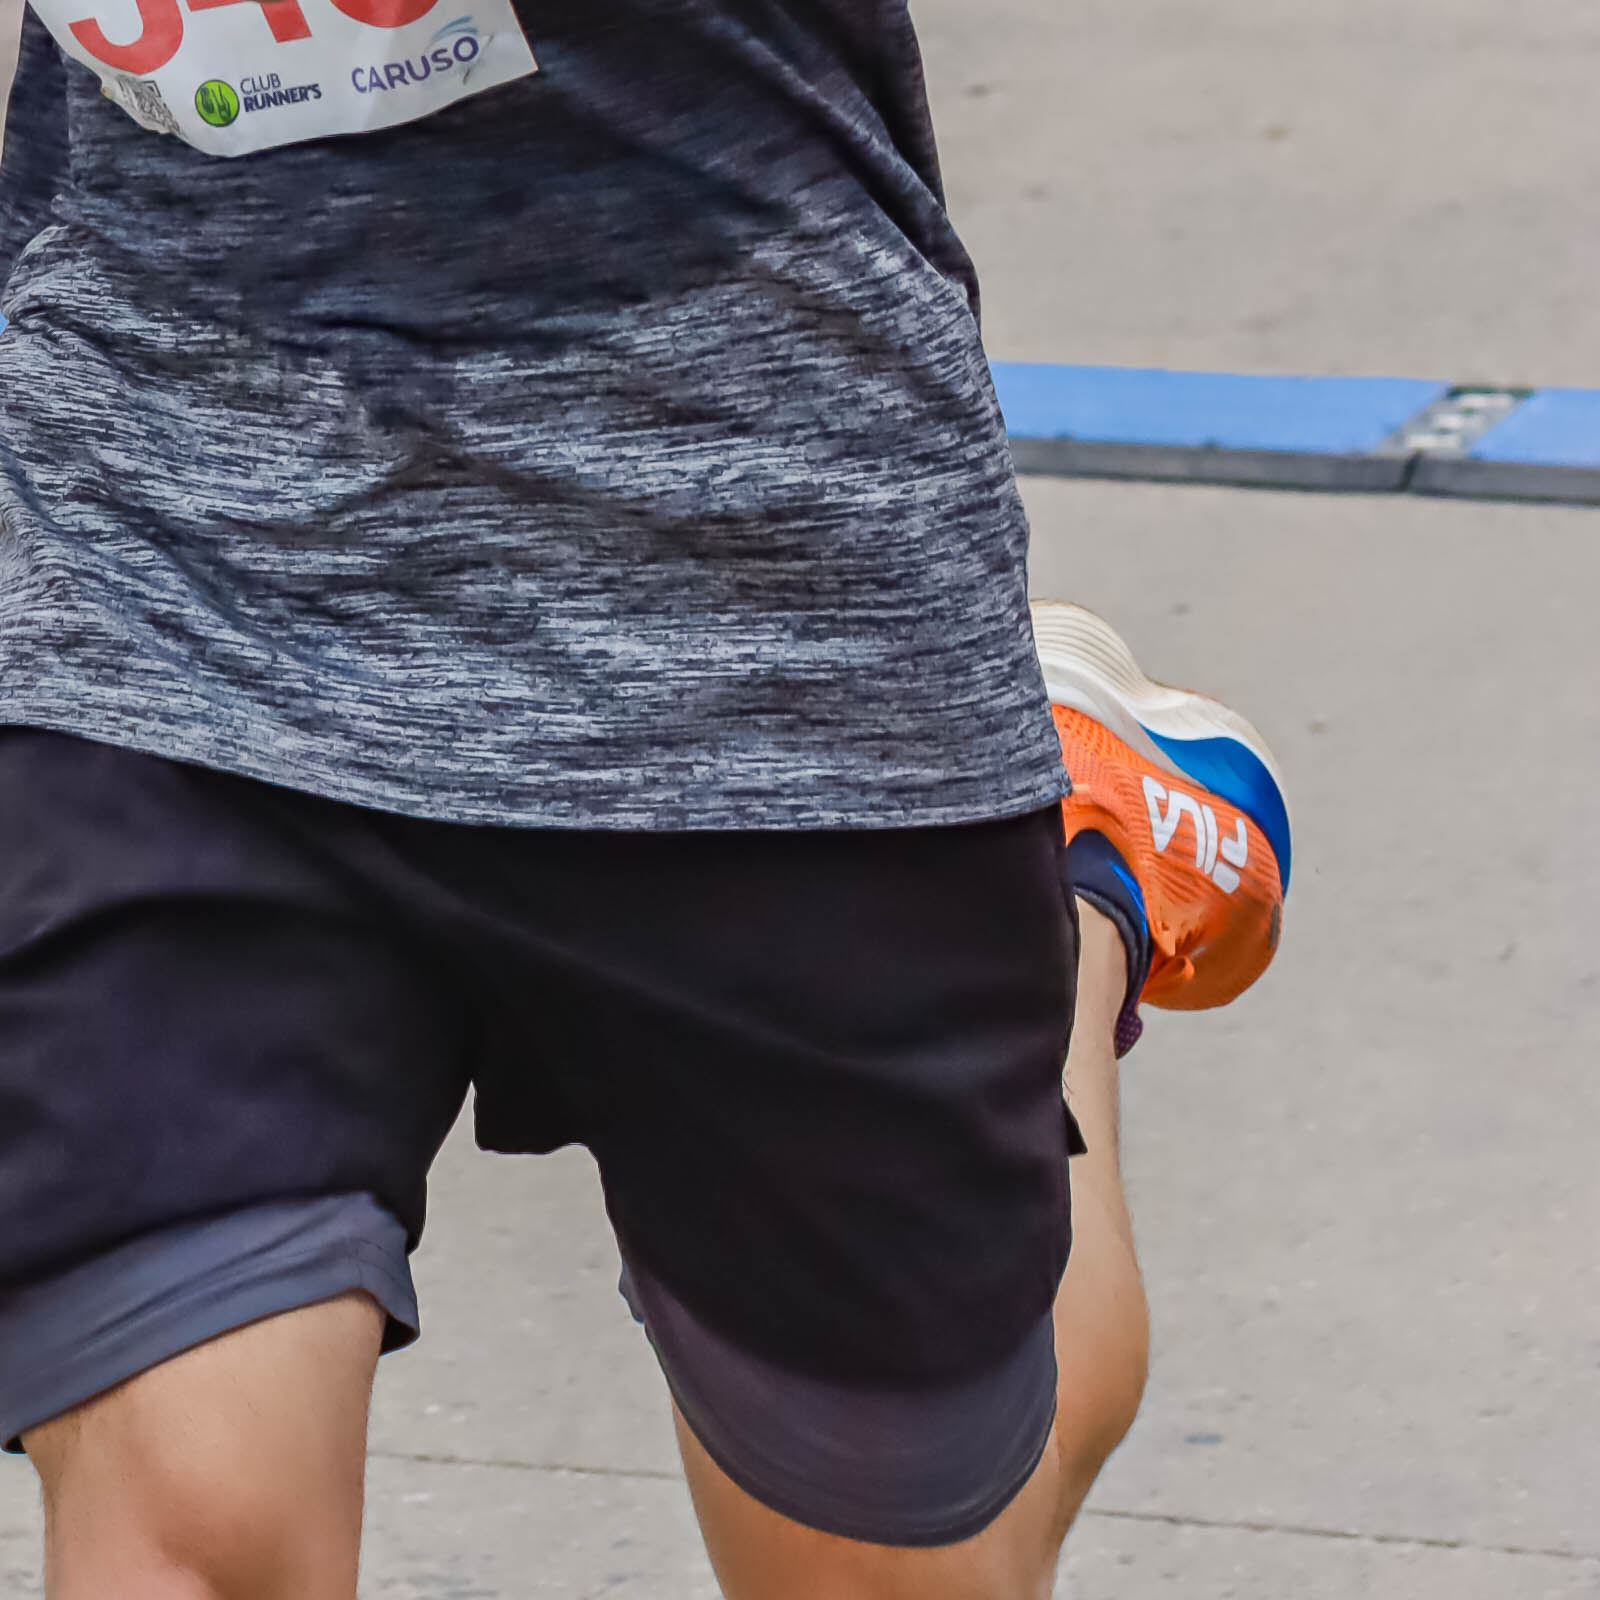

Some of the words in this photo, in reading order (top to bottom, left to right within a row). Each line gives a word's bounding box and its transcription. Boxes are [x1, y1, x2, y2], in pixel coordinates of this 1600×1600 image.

[239, 72, 282, 97] CLUB
[350, 34, 481, 94] CARUSO
[243, 83, 323, 113] RUNNER'S
[1141, 774, 1248, 894] FILA
